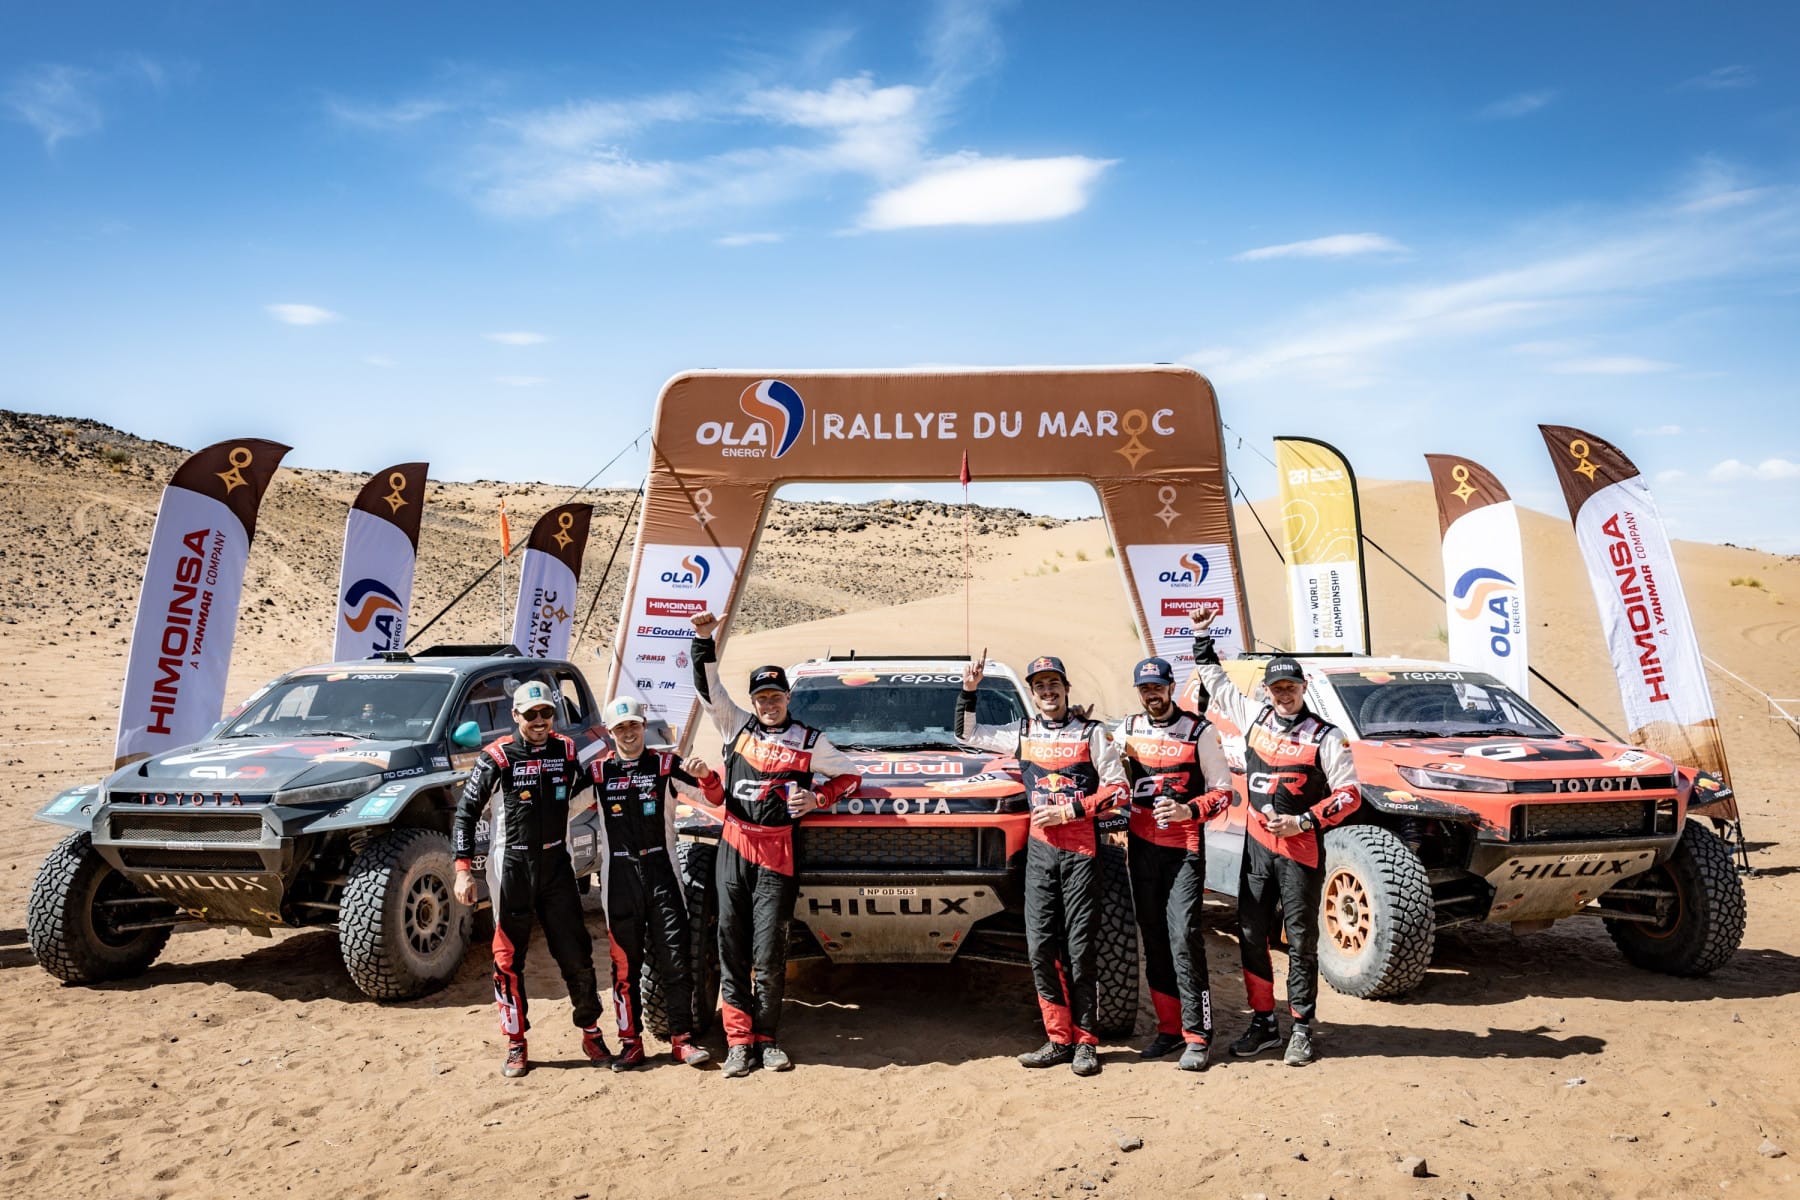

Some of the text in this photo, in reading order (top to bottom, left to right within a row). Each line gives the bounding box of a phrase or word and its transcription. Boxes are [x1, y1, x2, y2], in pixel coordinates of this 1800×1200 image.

[696, 422, 767, 445] OLA
[823, 408, 1175, 445] RALLYE DU MAROC
[722, 448, 766, 458] ENERGY
[1624, 511, 1646, 559] COMPANY
[661, 572, 693, 584] OLA
[1159, 571, 1192, 582] OLA
[191, 591, 214, 656] YANMAR
[206, 530, 227, 585] COMPANY
[535, 588, 543, 607] DU
[1309, 578, 1318, 609] WORLD
[1641, 565, 1666, 625] YANMAR
[649, 601, 703, 611] HIMOINSA
[1164, 601, 1219, 609] HIMOINSA
[1330, 570, 1343, 638] CHAMPIONSHIP
[1601, 513, 1669, 703] HIMOINSA
[1512, 596, 1520, 634] ENERGY
[147, 528, 211, 735] HIMOINSA
[393, 617, 402, 651] NERGY
[637, 626, 696, 638] BFGoodric
[1489, 596, 1511, 657] OLA
[637, 680, 652, 688] FIA
[756, 671, 779, 681] GR
[889, 674, 963, 685] repso
[1403, 671, 1464, 682] repsol
[1030, 745, 1078, 760] repsol
[1134, 742, 1184, 757] repsol
[1256, 735, 1305, 757] repsol
[514, 765, 538, 775] GR
[895, 761, 963, 775] Bull
[606, 781, 629, 790] GR
[1133, 771, 1190, 798] GR
[1249, 771, 1308, 796] GR
[1552, 777, 1642, 793] TOYOTA
[139, 792, 243, 806] TOYOTA
[1384, 802, 1418, 810] repsol
[1098, 817, 1128, 829] epsol
[1509, 859, 1632, 880] HILUX
[144, 874, 268, 891] HILUX
[808, 898, 969, 915] HILUX
